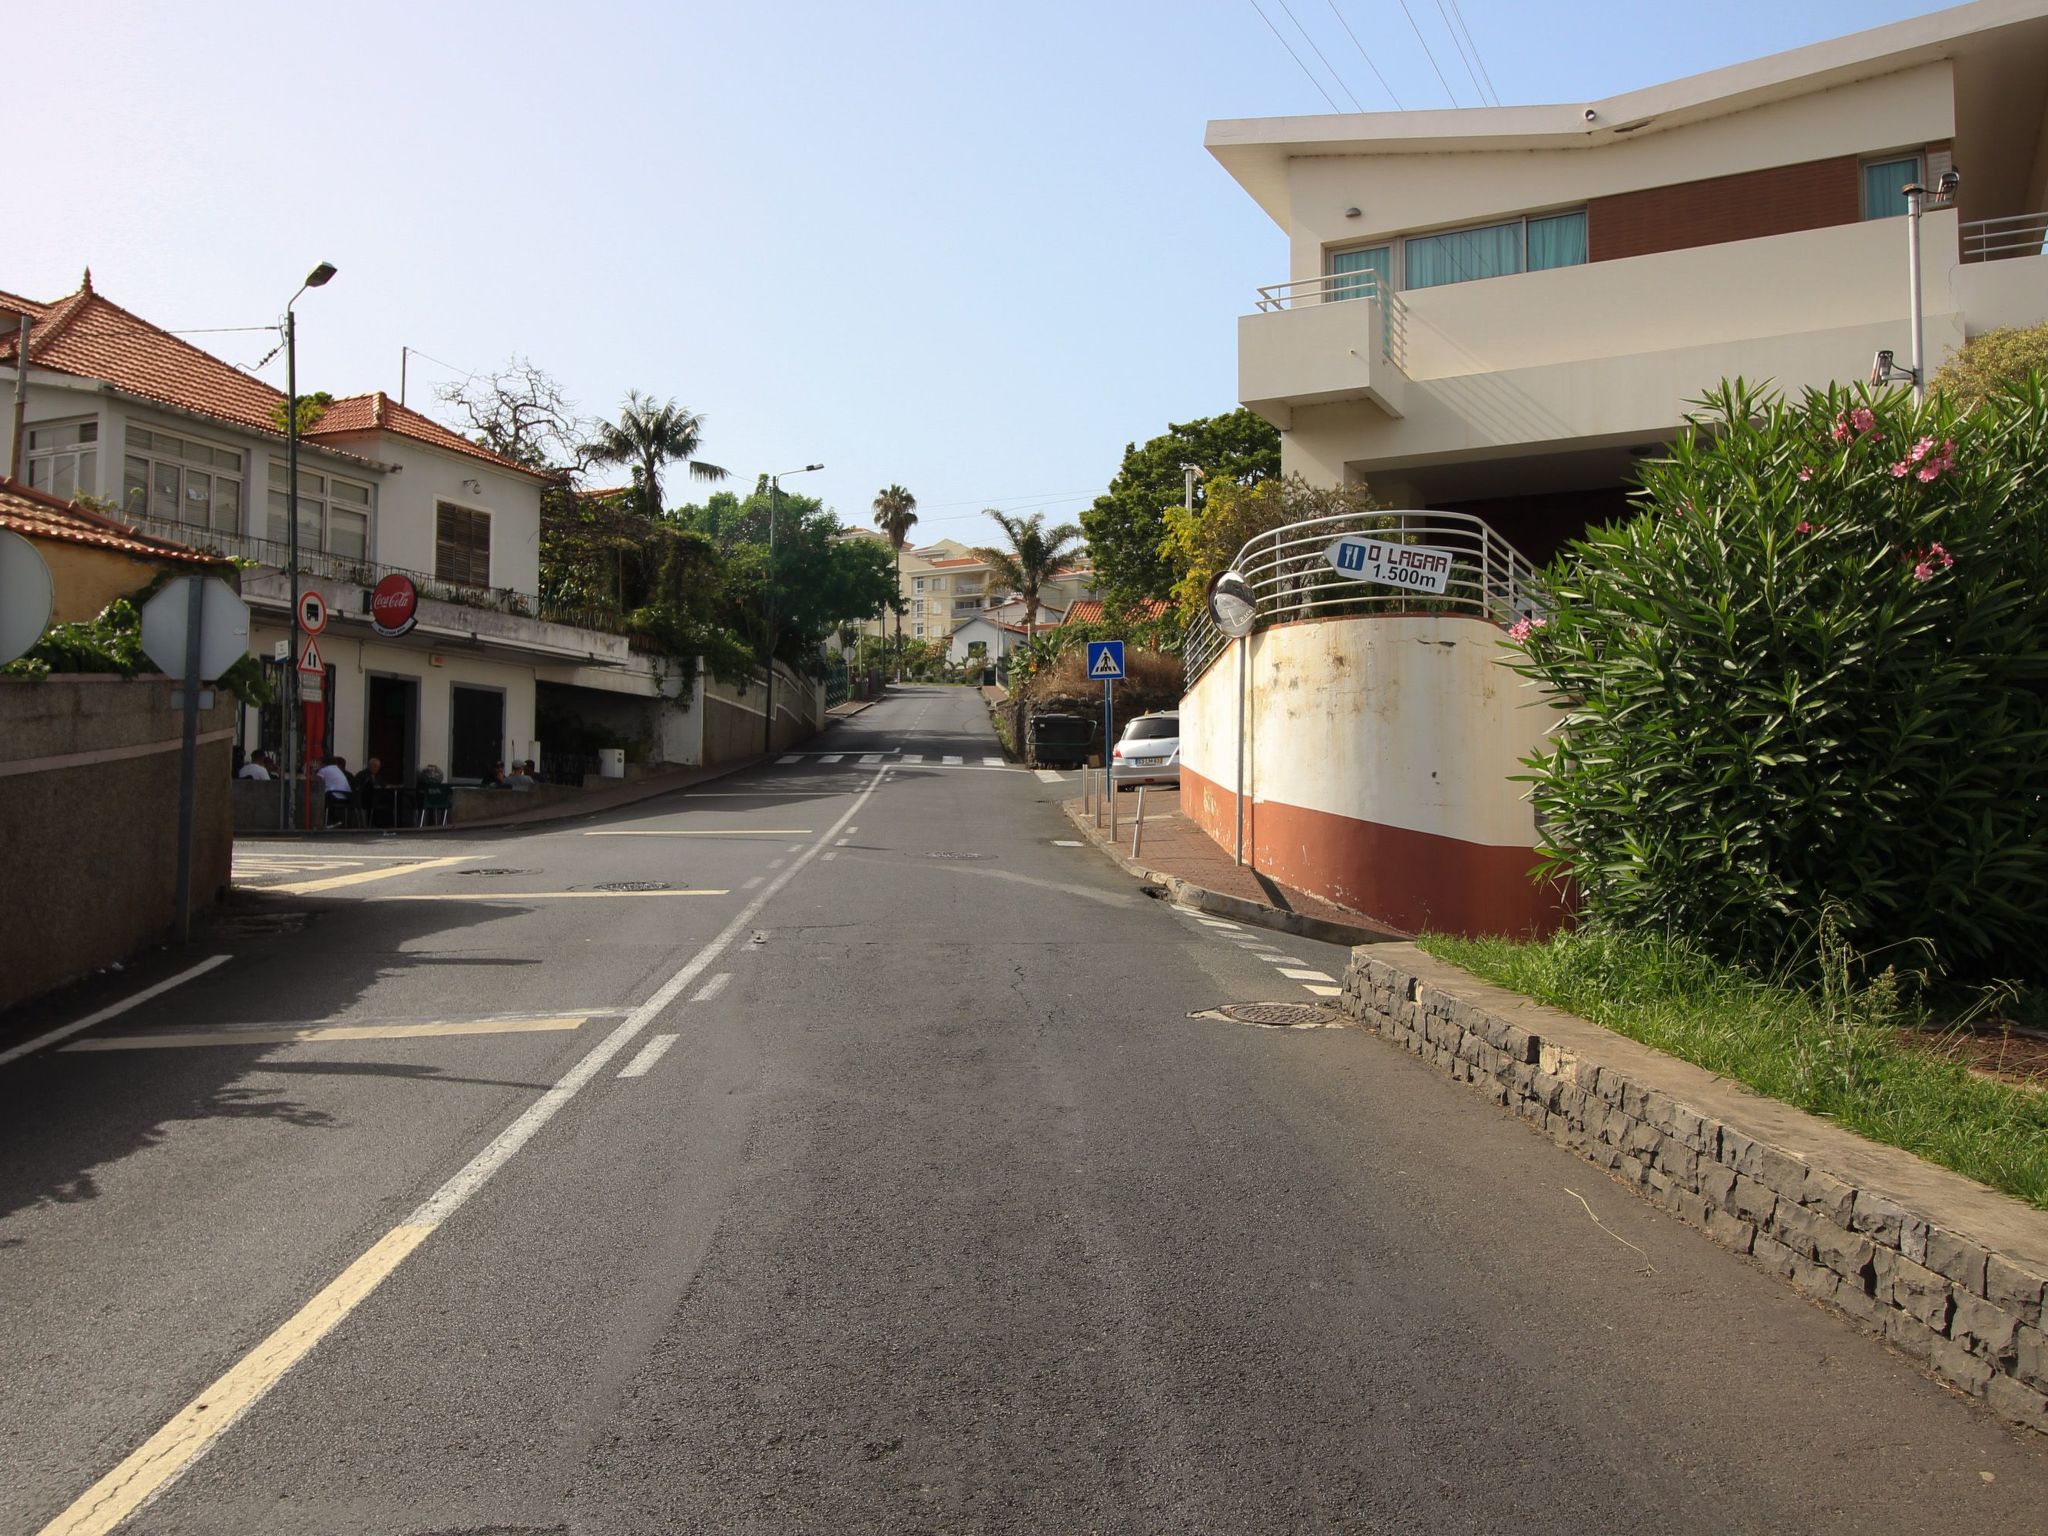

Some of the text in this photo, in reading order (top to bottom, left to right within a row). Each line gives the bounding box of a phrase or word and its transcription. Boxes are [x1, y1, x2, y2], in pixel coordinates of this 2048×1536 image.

[1367, 544, 1448, 574] O LAGAR
[1373, 563, 1436, 588] 1.500m
